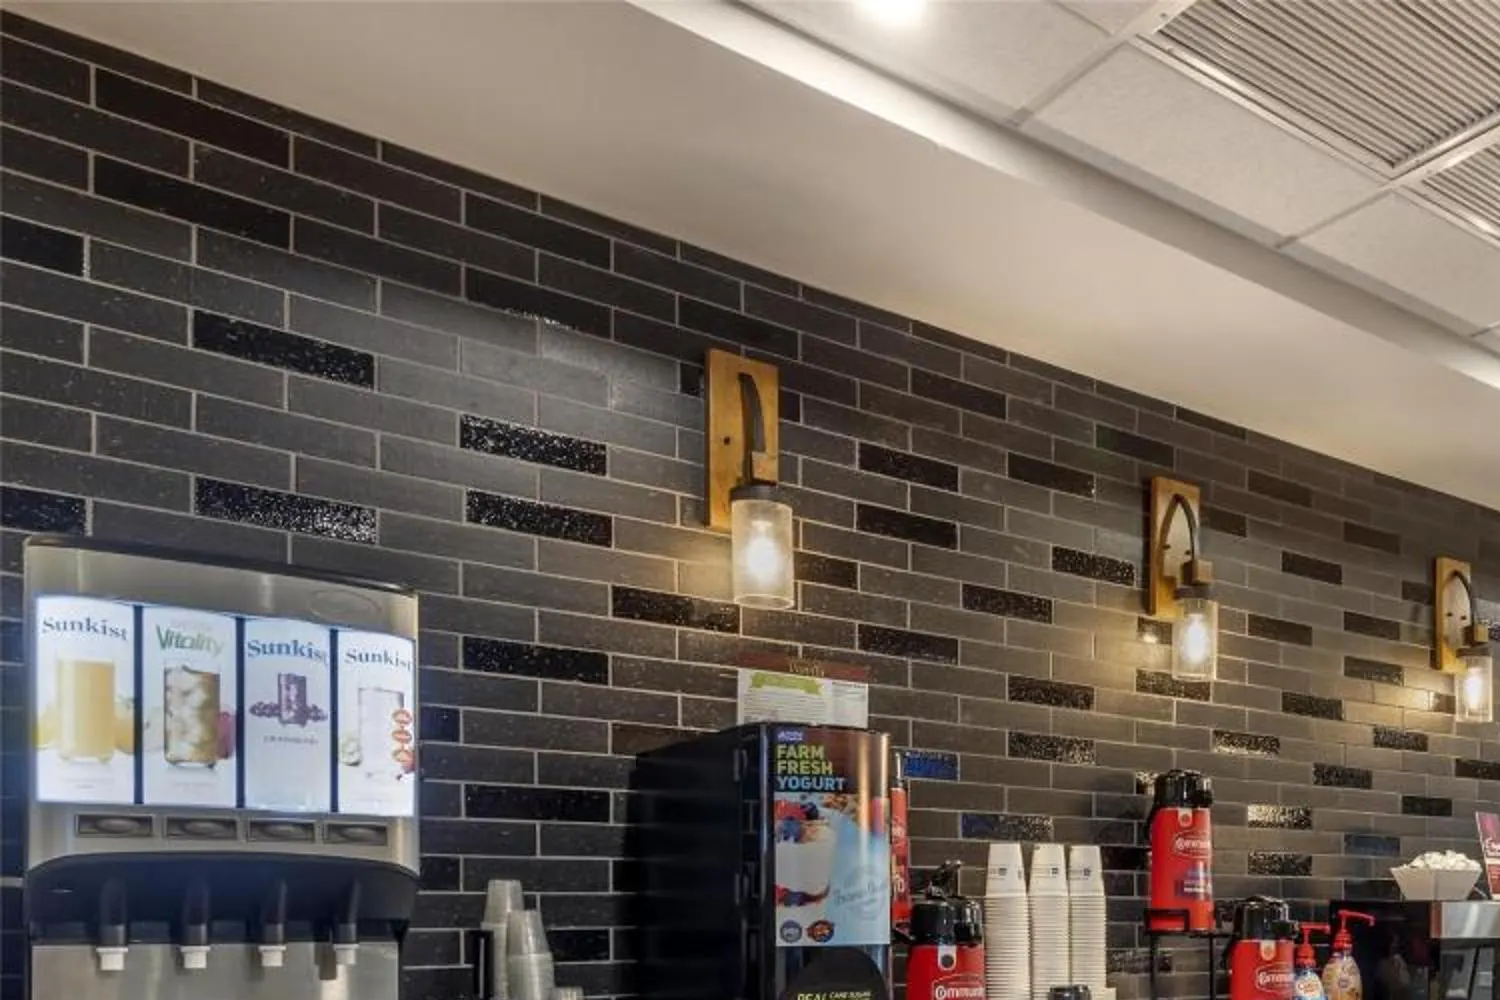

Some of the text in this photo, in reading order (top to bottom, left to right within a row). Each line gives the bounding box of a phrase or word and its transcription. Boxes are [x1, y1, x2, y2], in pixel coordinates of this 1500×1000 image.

[43, 615, 128, 642] Sunkist
[156, 623, 224, 658] Vitality
[247, 638, 329, 666] Sunkist
[344, 648, 413, 672] Sunkist
[776, 743, 825, 760] FARM
[776, 759, 834, 776] FRESH
[776, 774, 846, 792] YOGURT
